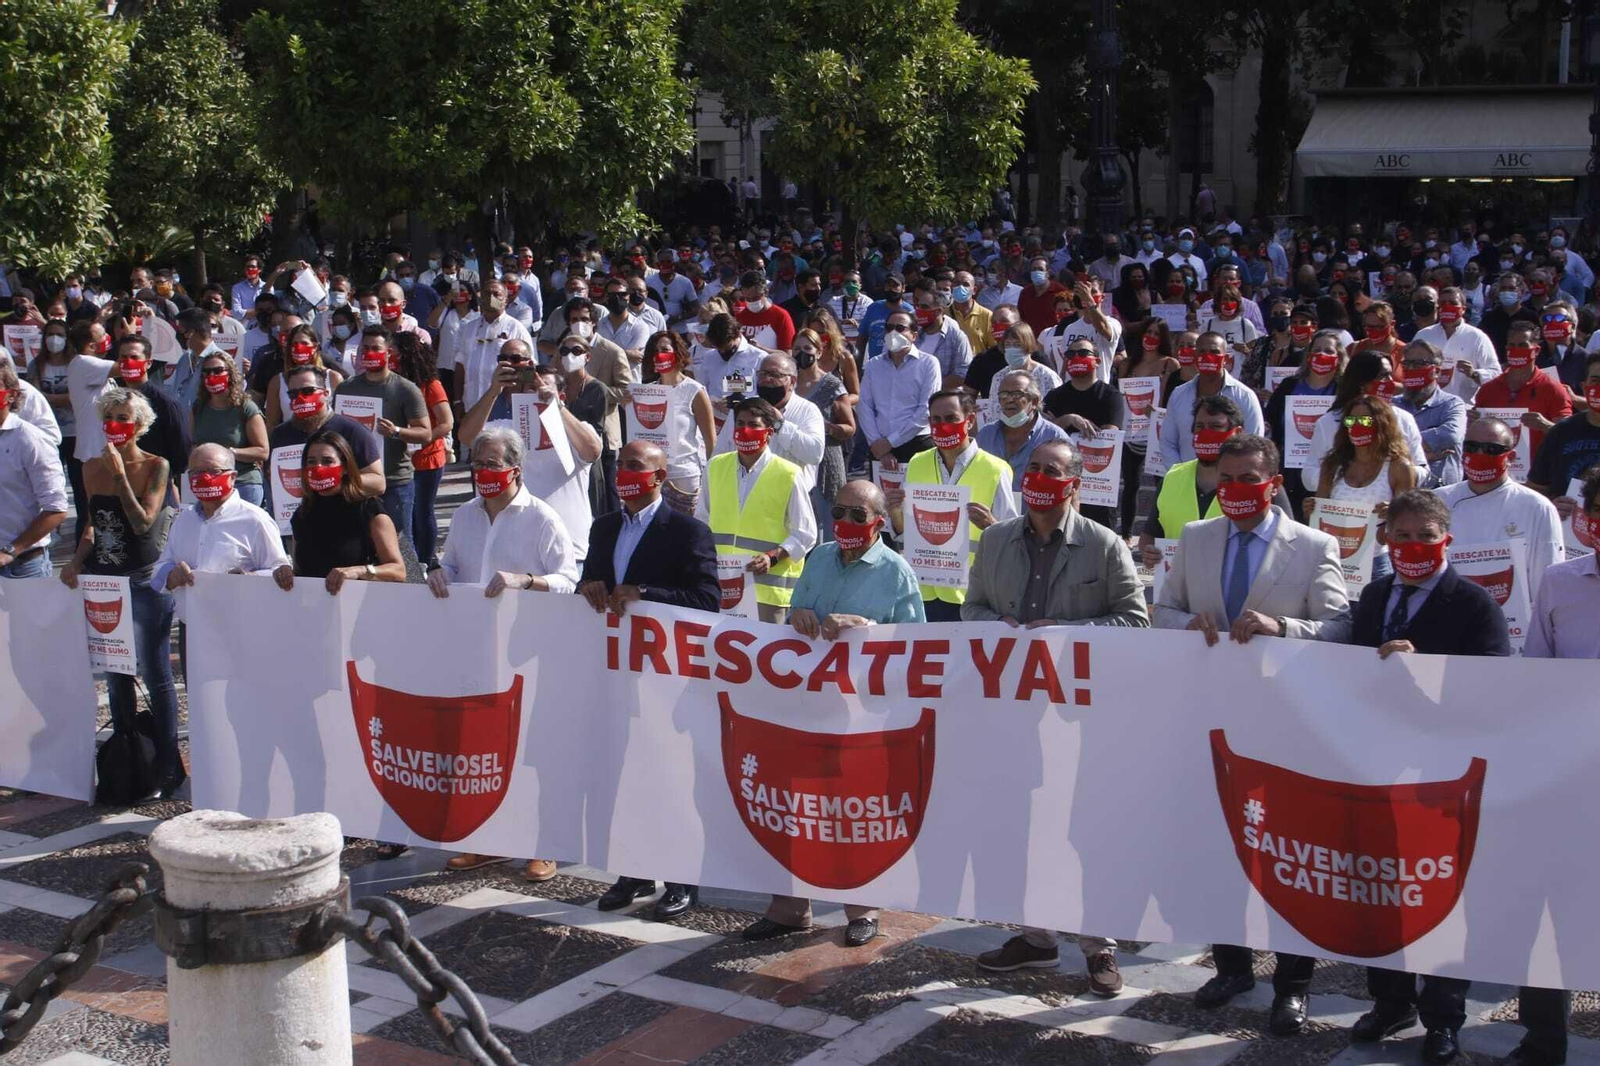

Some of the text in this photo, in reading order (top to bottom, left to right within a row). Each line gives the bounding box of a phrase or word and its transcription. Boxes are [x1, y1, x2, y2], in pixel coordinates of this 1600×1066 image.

[1374, 154, 1411, 168] ABC
[1493, 153, 1532, 167] ABC
[913, 489, 946, 498] ¡RESCATE
[912, 557, 923, 565] YO
[924, 559, 937, 567] ME
[938, 560, 961, 568] SUMO
[915, 548, 958, 557] CONCENTRACIÓN
[1451, 548, 1510, 561] ¡RESCATE YA!
[108, 647, 129, 655] SUMO
[606, 612, 1092, 706] ¡RESCATE YA!
[370, 739, 503, 776] SALVEMOSEL
[372, 760, 502, 795] OCIONOCTURNO
[740, 778, 914, 819] SALVEMOSLA
[746, 802, 908, 843] HOSTELERIA
[1243, 825, 1454, 882] SALVEMOSLOS
[1273, 862, 1423, 907] CATERING
